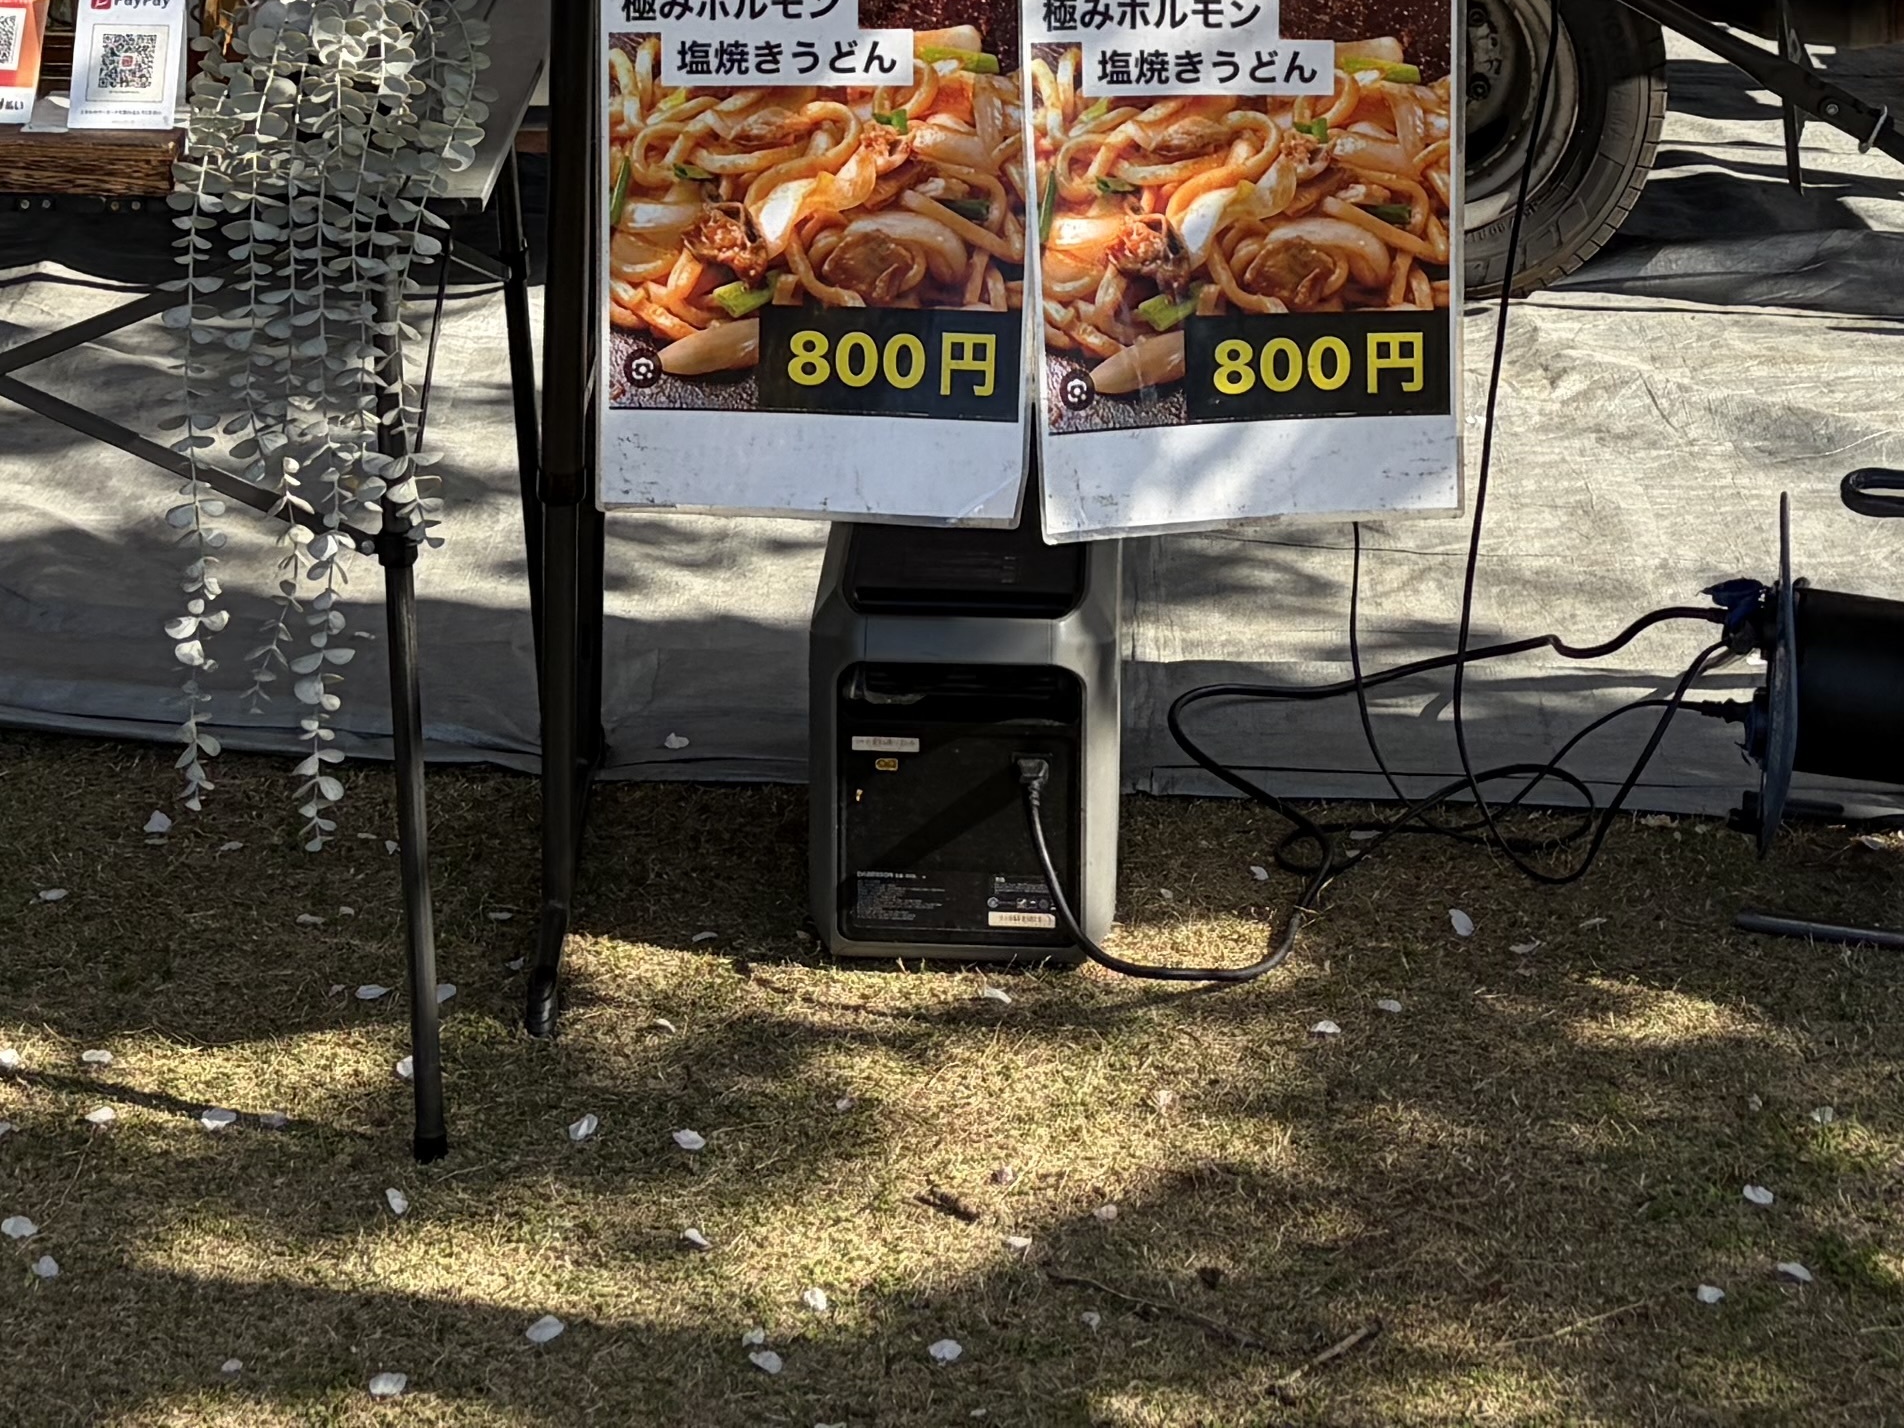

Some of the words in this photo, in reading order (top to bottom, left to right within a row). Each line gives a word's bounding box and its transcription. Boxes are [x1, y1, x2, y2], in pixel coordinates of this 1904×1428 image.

[676, 39, 898, 77] 塩焼きうどん
[1098, 48, 1318, 85] 塩焼きうどん
[786, 329, 998, 397] 800円
[1212, 331, 1426, 396] 800円
